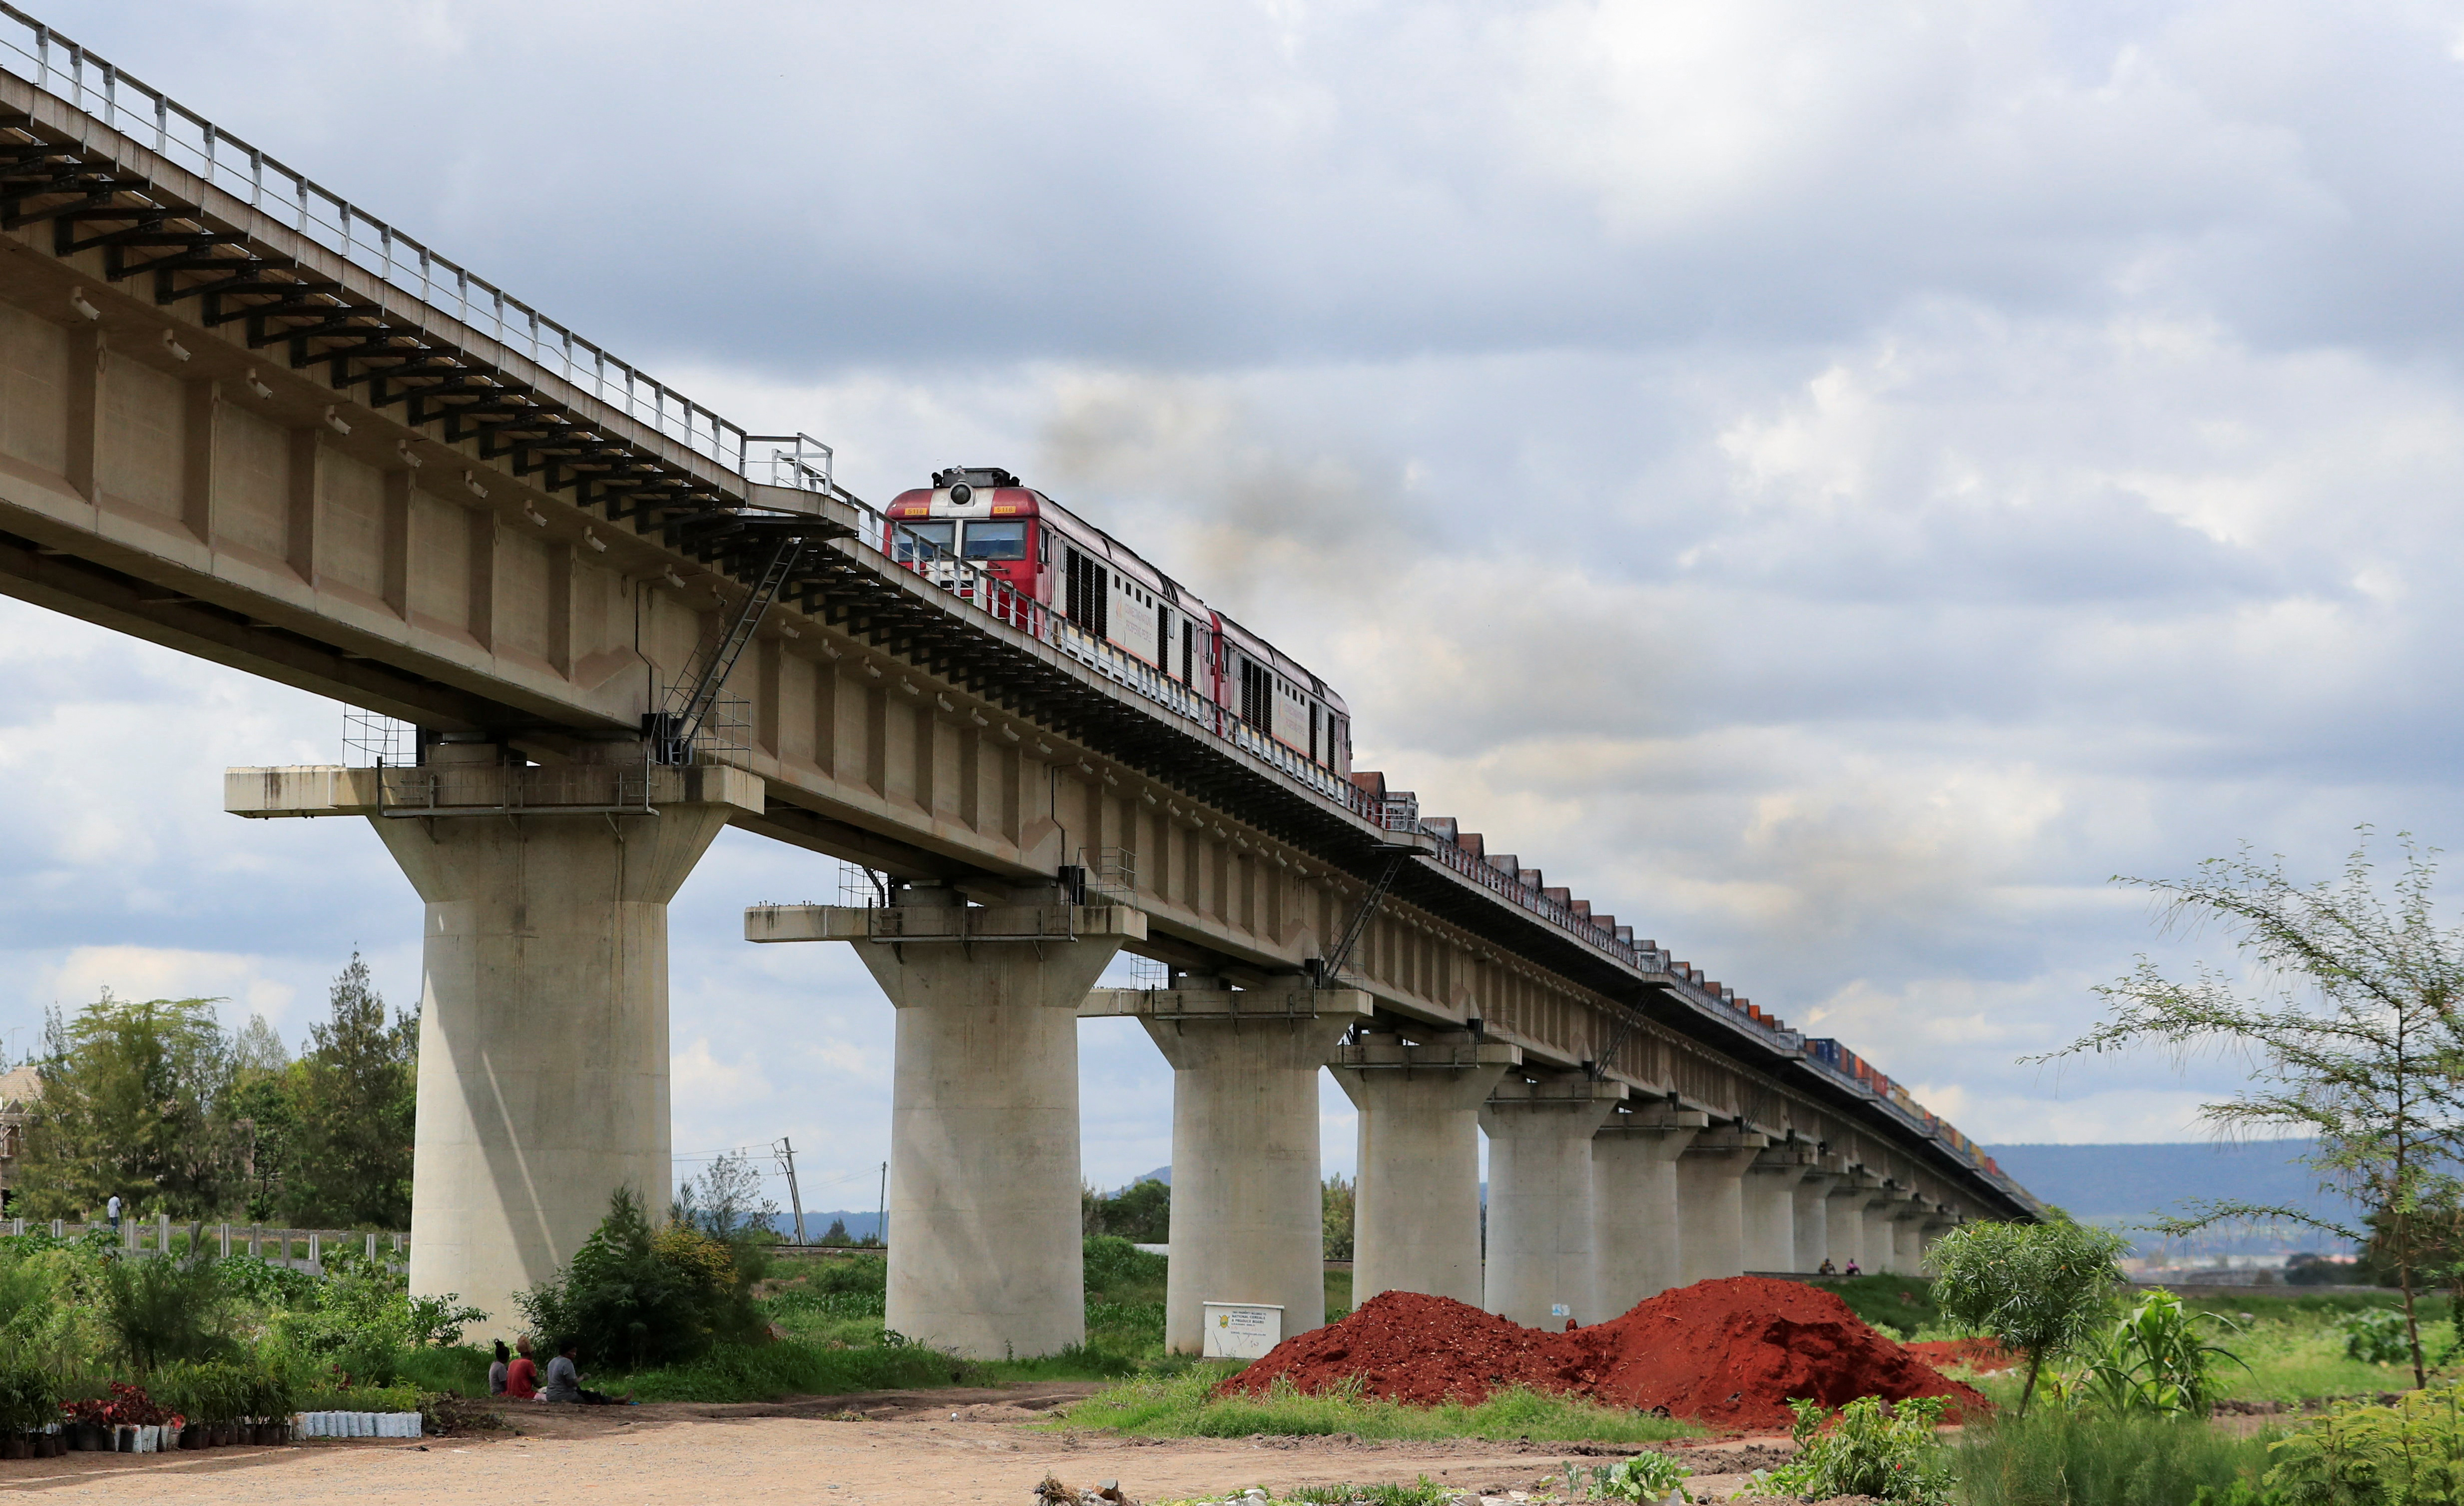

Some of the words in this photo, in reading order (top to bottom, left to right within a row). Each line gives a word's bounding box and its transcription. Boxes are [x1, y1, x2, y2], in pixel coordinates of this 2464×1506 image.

[1125, 603, 1141, 621] CONNECTING
[1141, 613, 1152, 628] NATIONS
[1126, 619, 1141, 637] PROSPERING
[1142, 628, 1151, 643] PEOPLE
